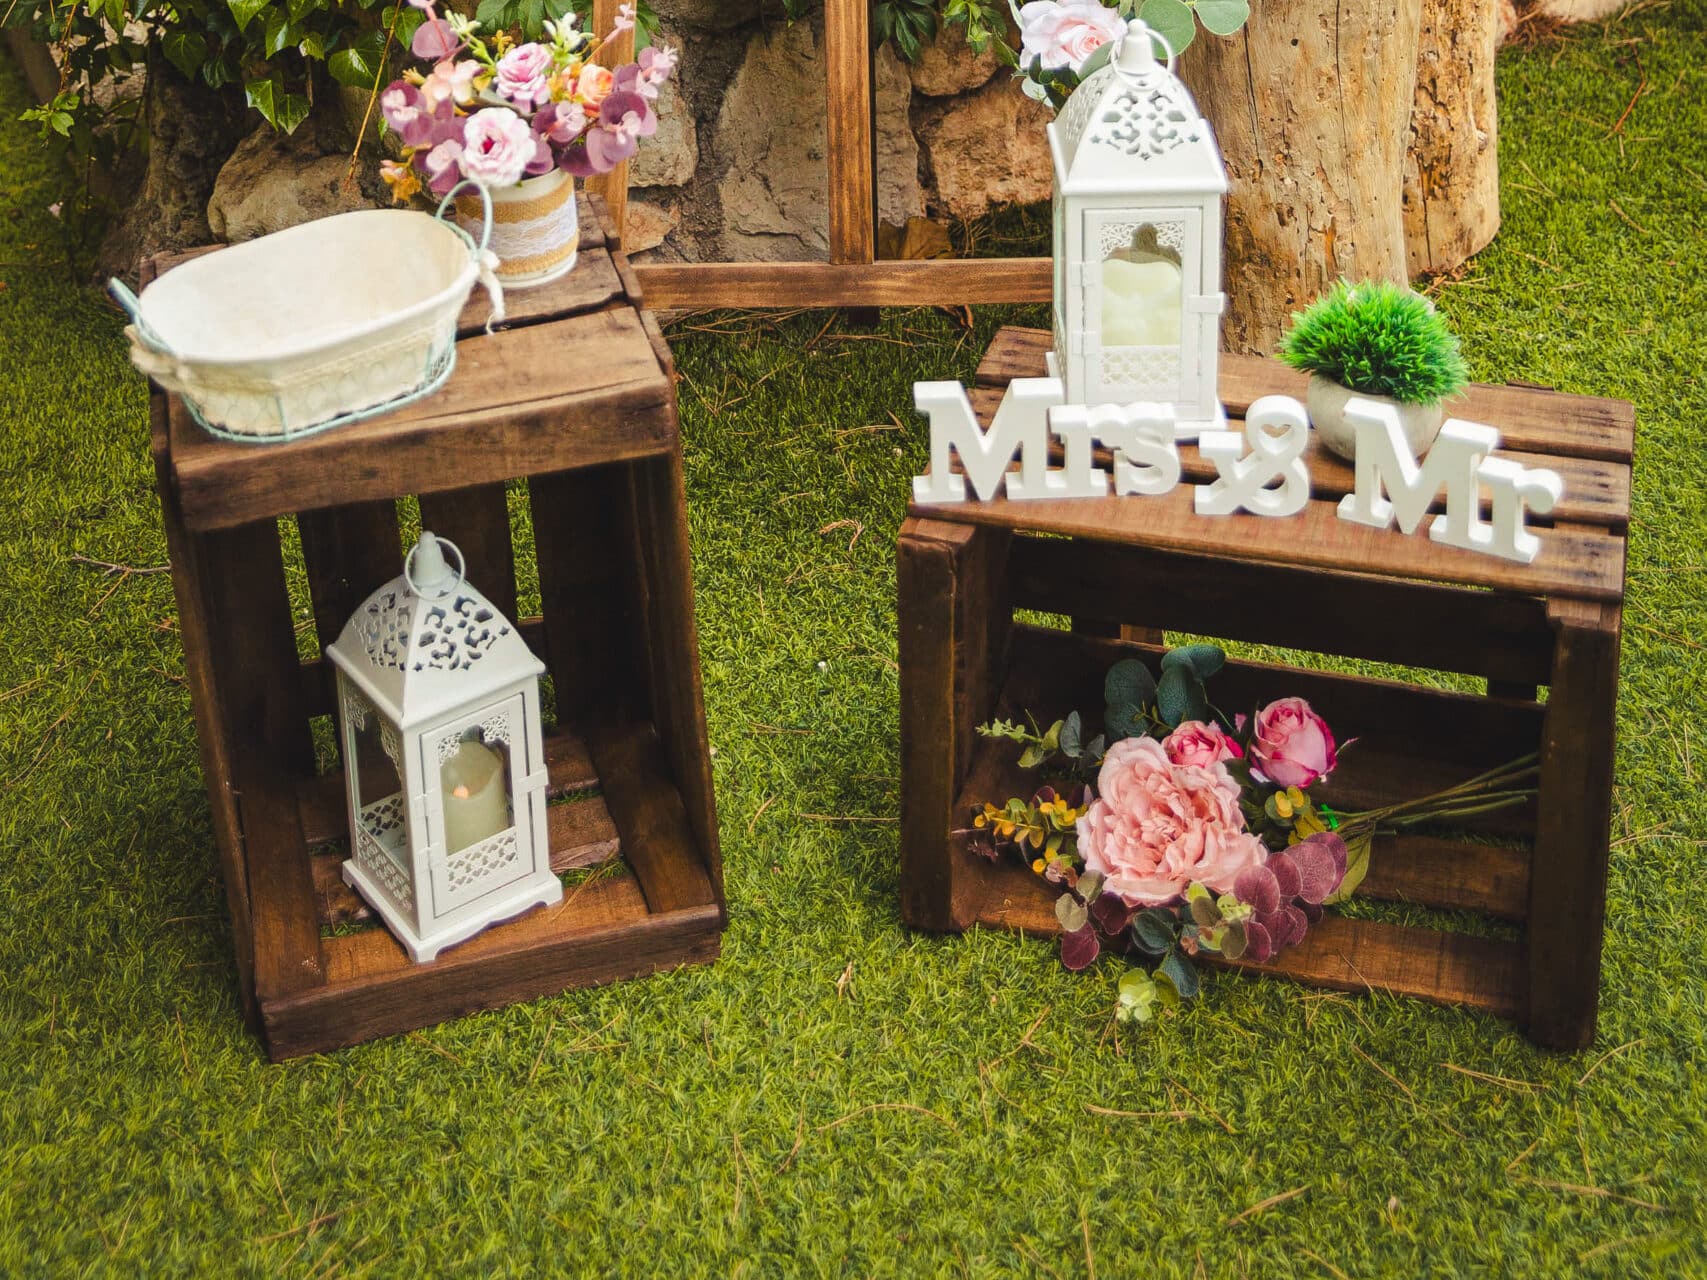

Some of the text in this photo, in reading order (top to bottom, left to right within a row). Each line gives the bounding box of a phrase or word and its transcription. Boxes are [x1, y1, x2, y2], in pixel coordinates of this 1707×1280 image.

[912, 376, 1564, 563] Mrs & Mr
